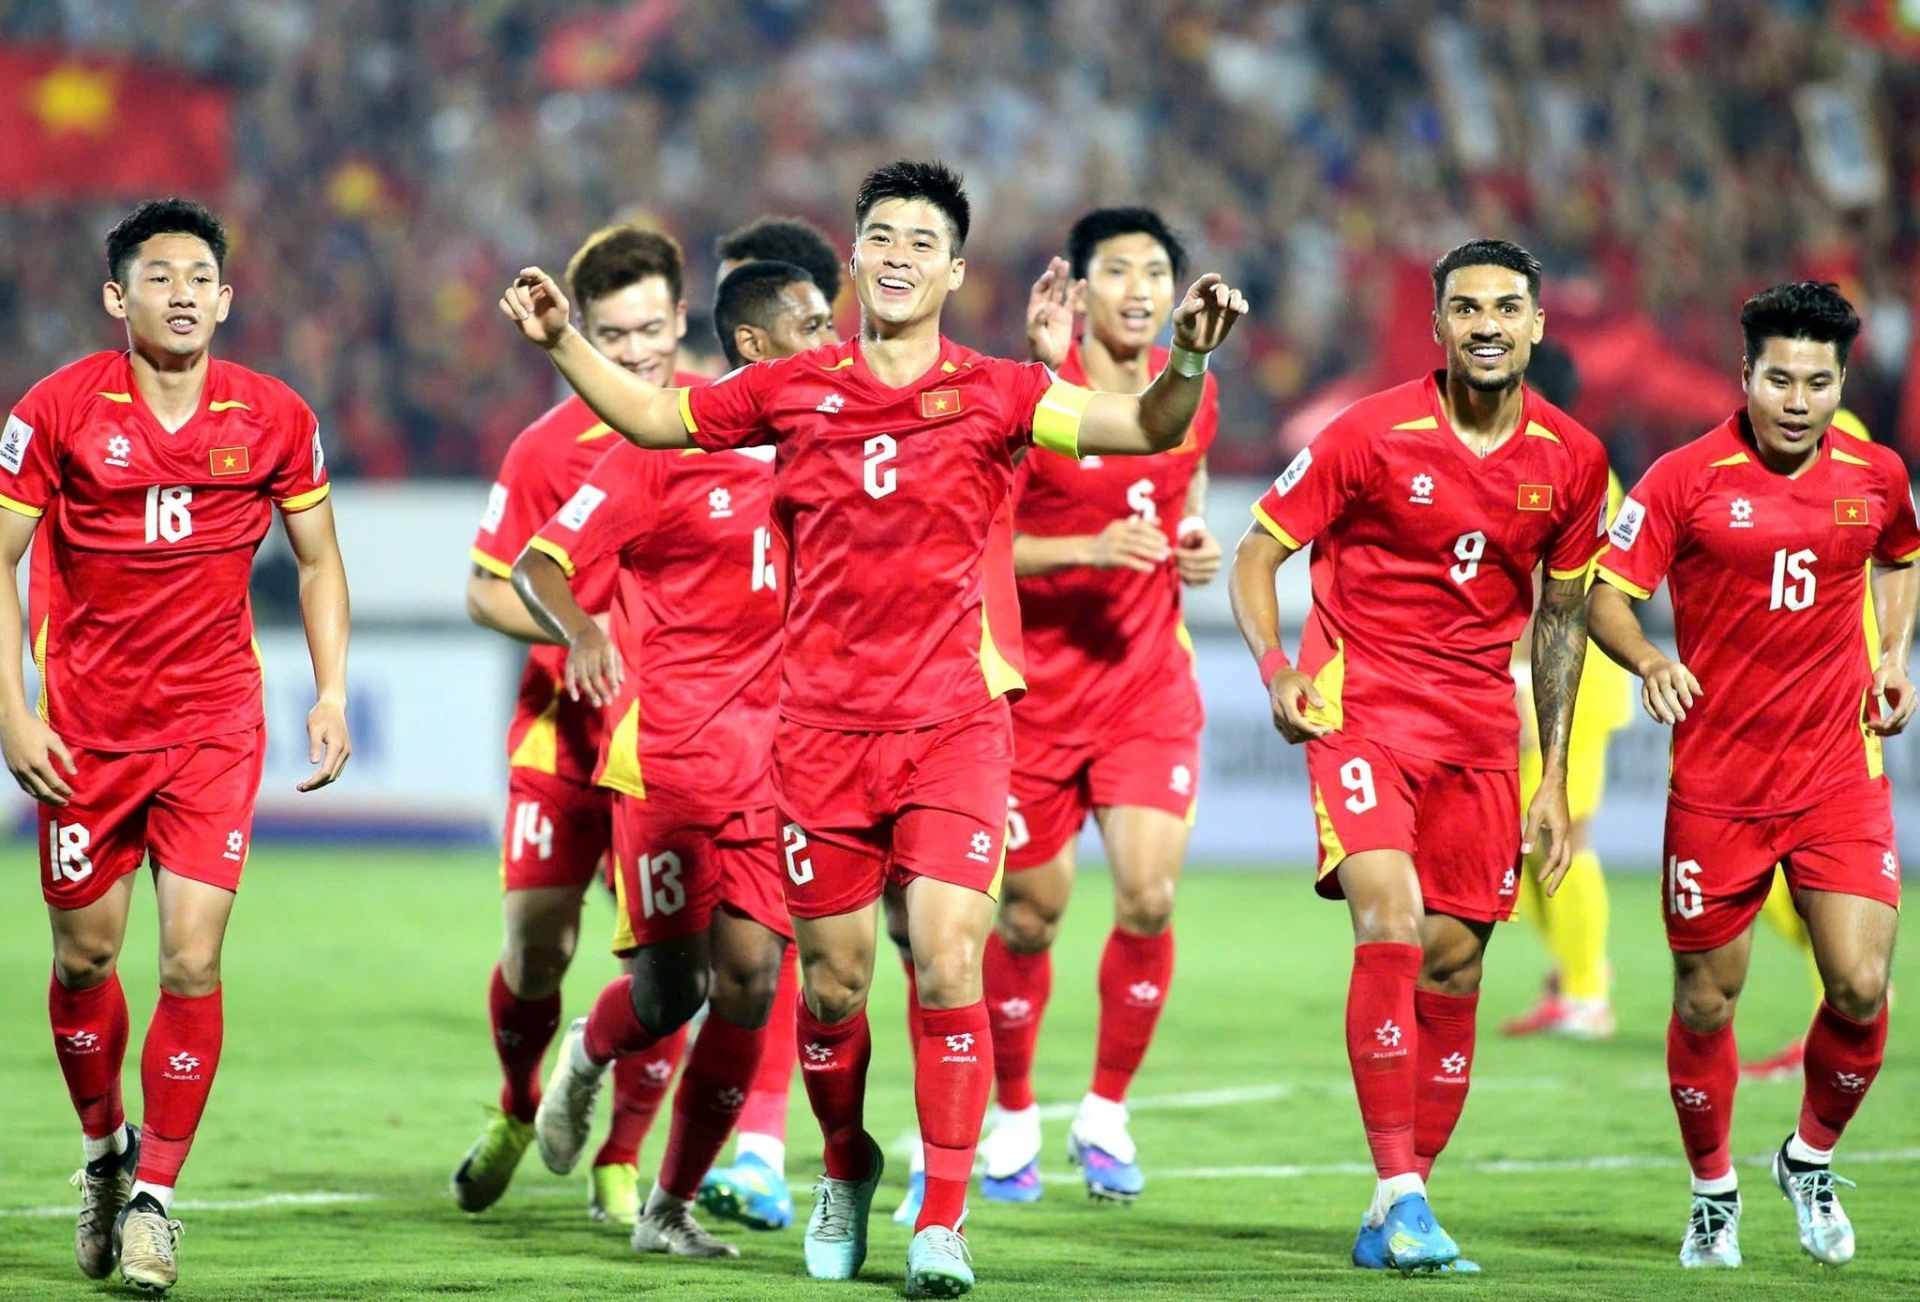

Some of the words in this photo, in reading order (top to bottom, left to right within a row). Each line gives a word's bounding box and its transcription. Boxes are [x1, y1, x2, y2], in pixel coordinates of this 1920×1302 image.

[863, 433, 897, 500] 2
[144, 484, 192, 544] 18
[1450, 530, 1487, 585] 9
[1769, 548, 1818, 612] 15
[1340, 757, 1377, 814] 9
[50, 819, 93, 883] 18
[511, 801, 554, 861] 14
[783, 822, 814, 886] 2
[638, 850, 685, 919] 13
[1669, 855, 1704, 920] 15
